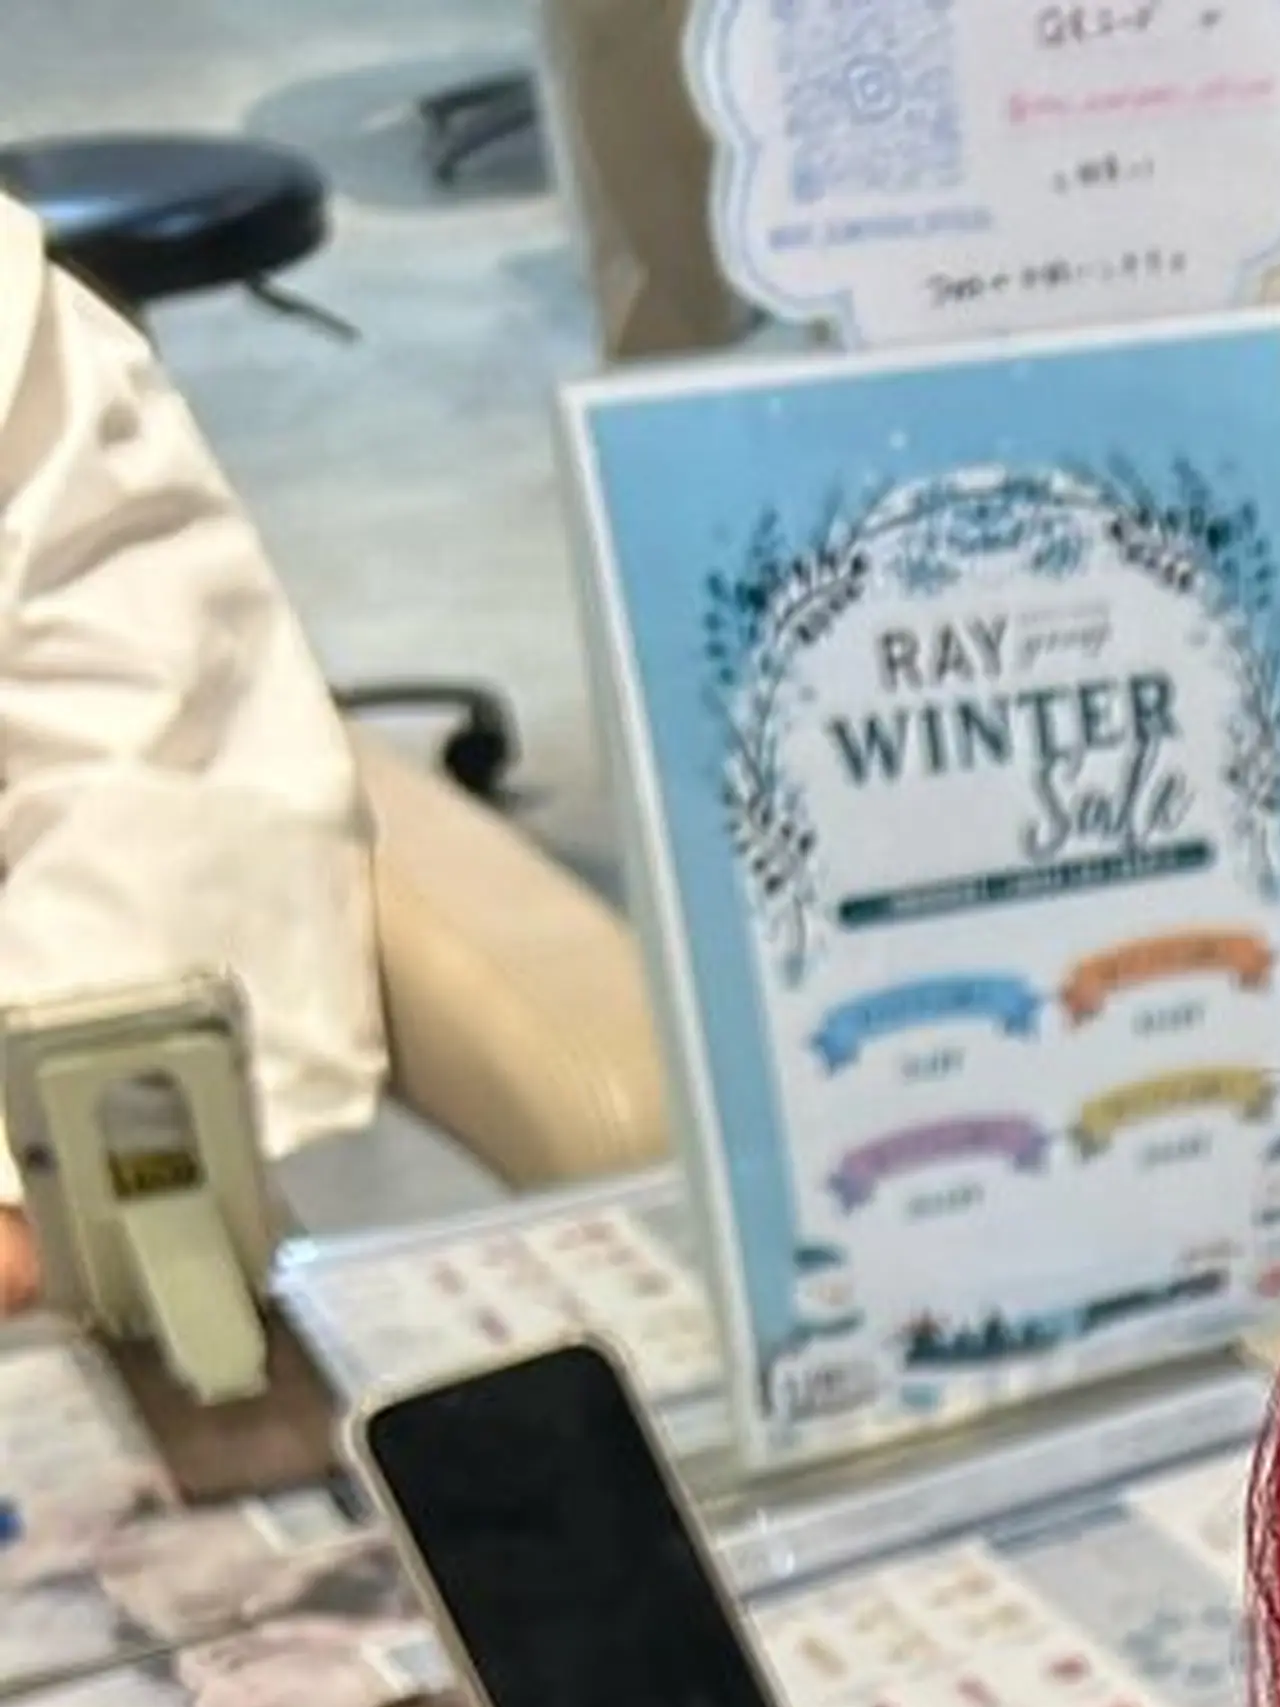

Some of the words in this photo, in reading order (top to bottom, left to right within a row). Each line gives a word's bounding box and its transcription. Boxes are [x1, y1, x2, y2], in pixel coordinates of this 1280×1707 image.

[880, 612, 1007, 690] RAY
[828, 673, 1178, 784] WINTER
[1021, 740, 1195, 863] Sale
